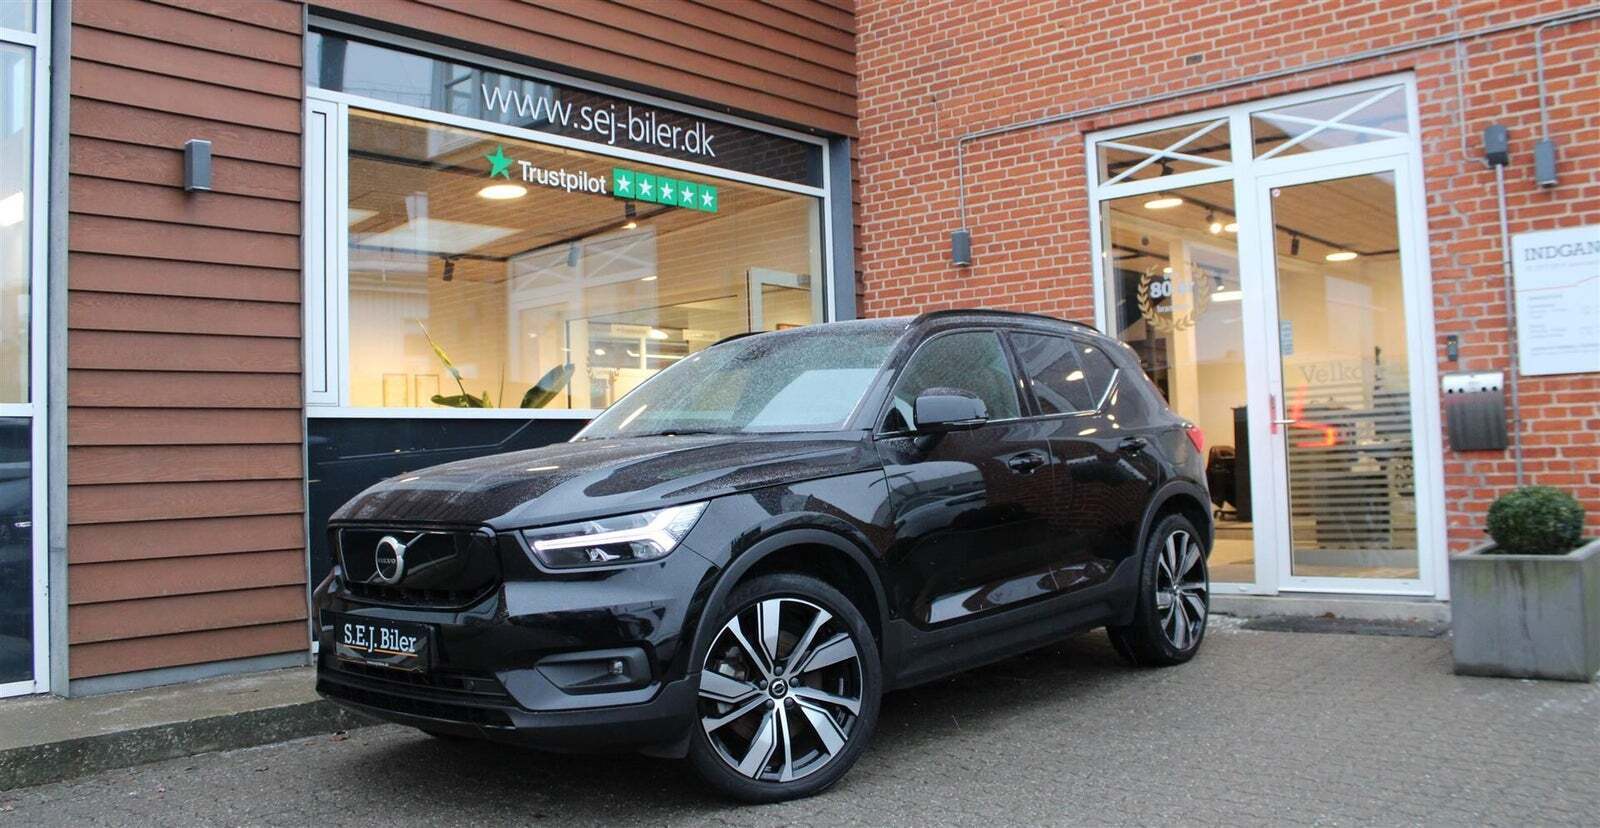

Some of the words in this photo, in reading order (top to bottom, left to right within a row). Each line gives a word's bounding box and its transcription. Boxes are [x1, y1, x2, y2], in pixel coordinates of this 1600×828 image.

[482, 83, 716, 157] www.sej-biler.dk
[518, 160, 607, 194] Trustpilot
[1150, 280, 1173, 298] 80
[344, 623, 378, 652] S.E.J.
[380, 627, 416, 652] Biler
